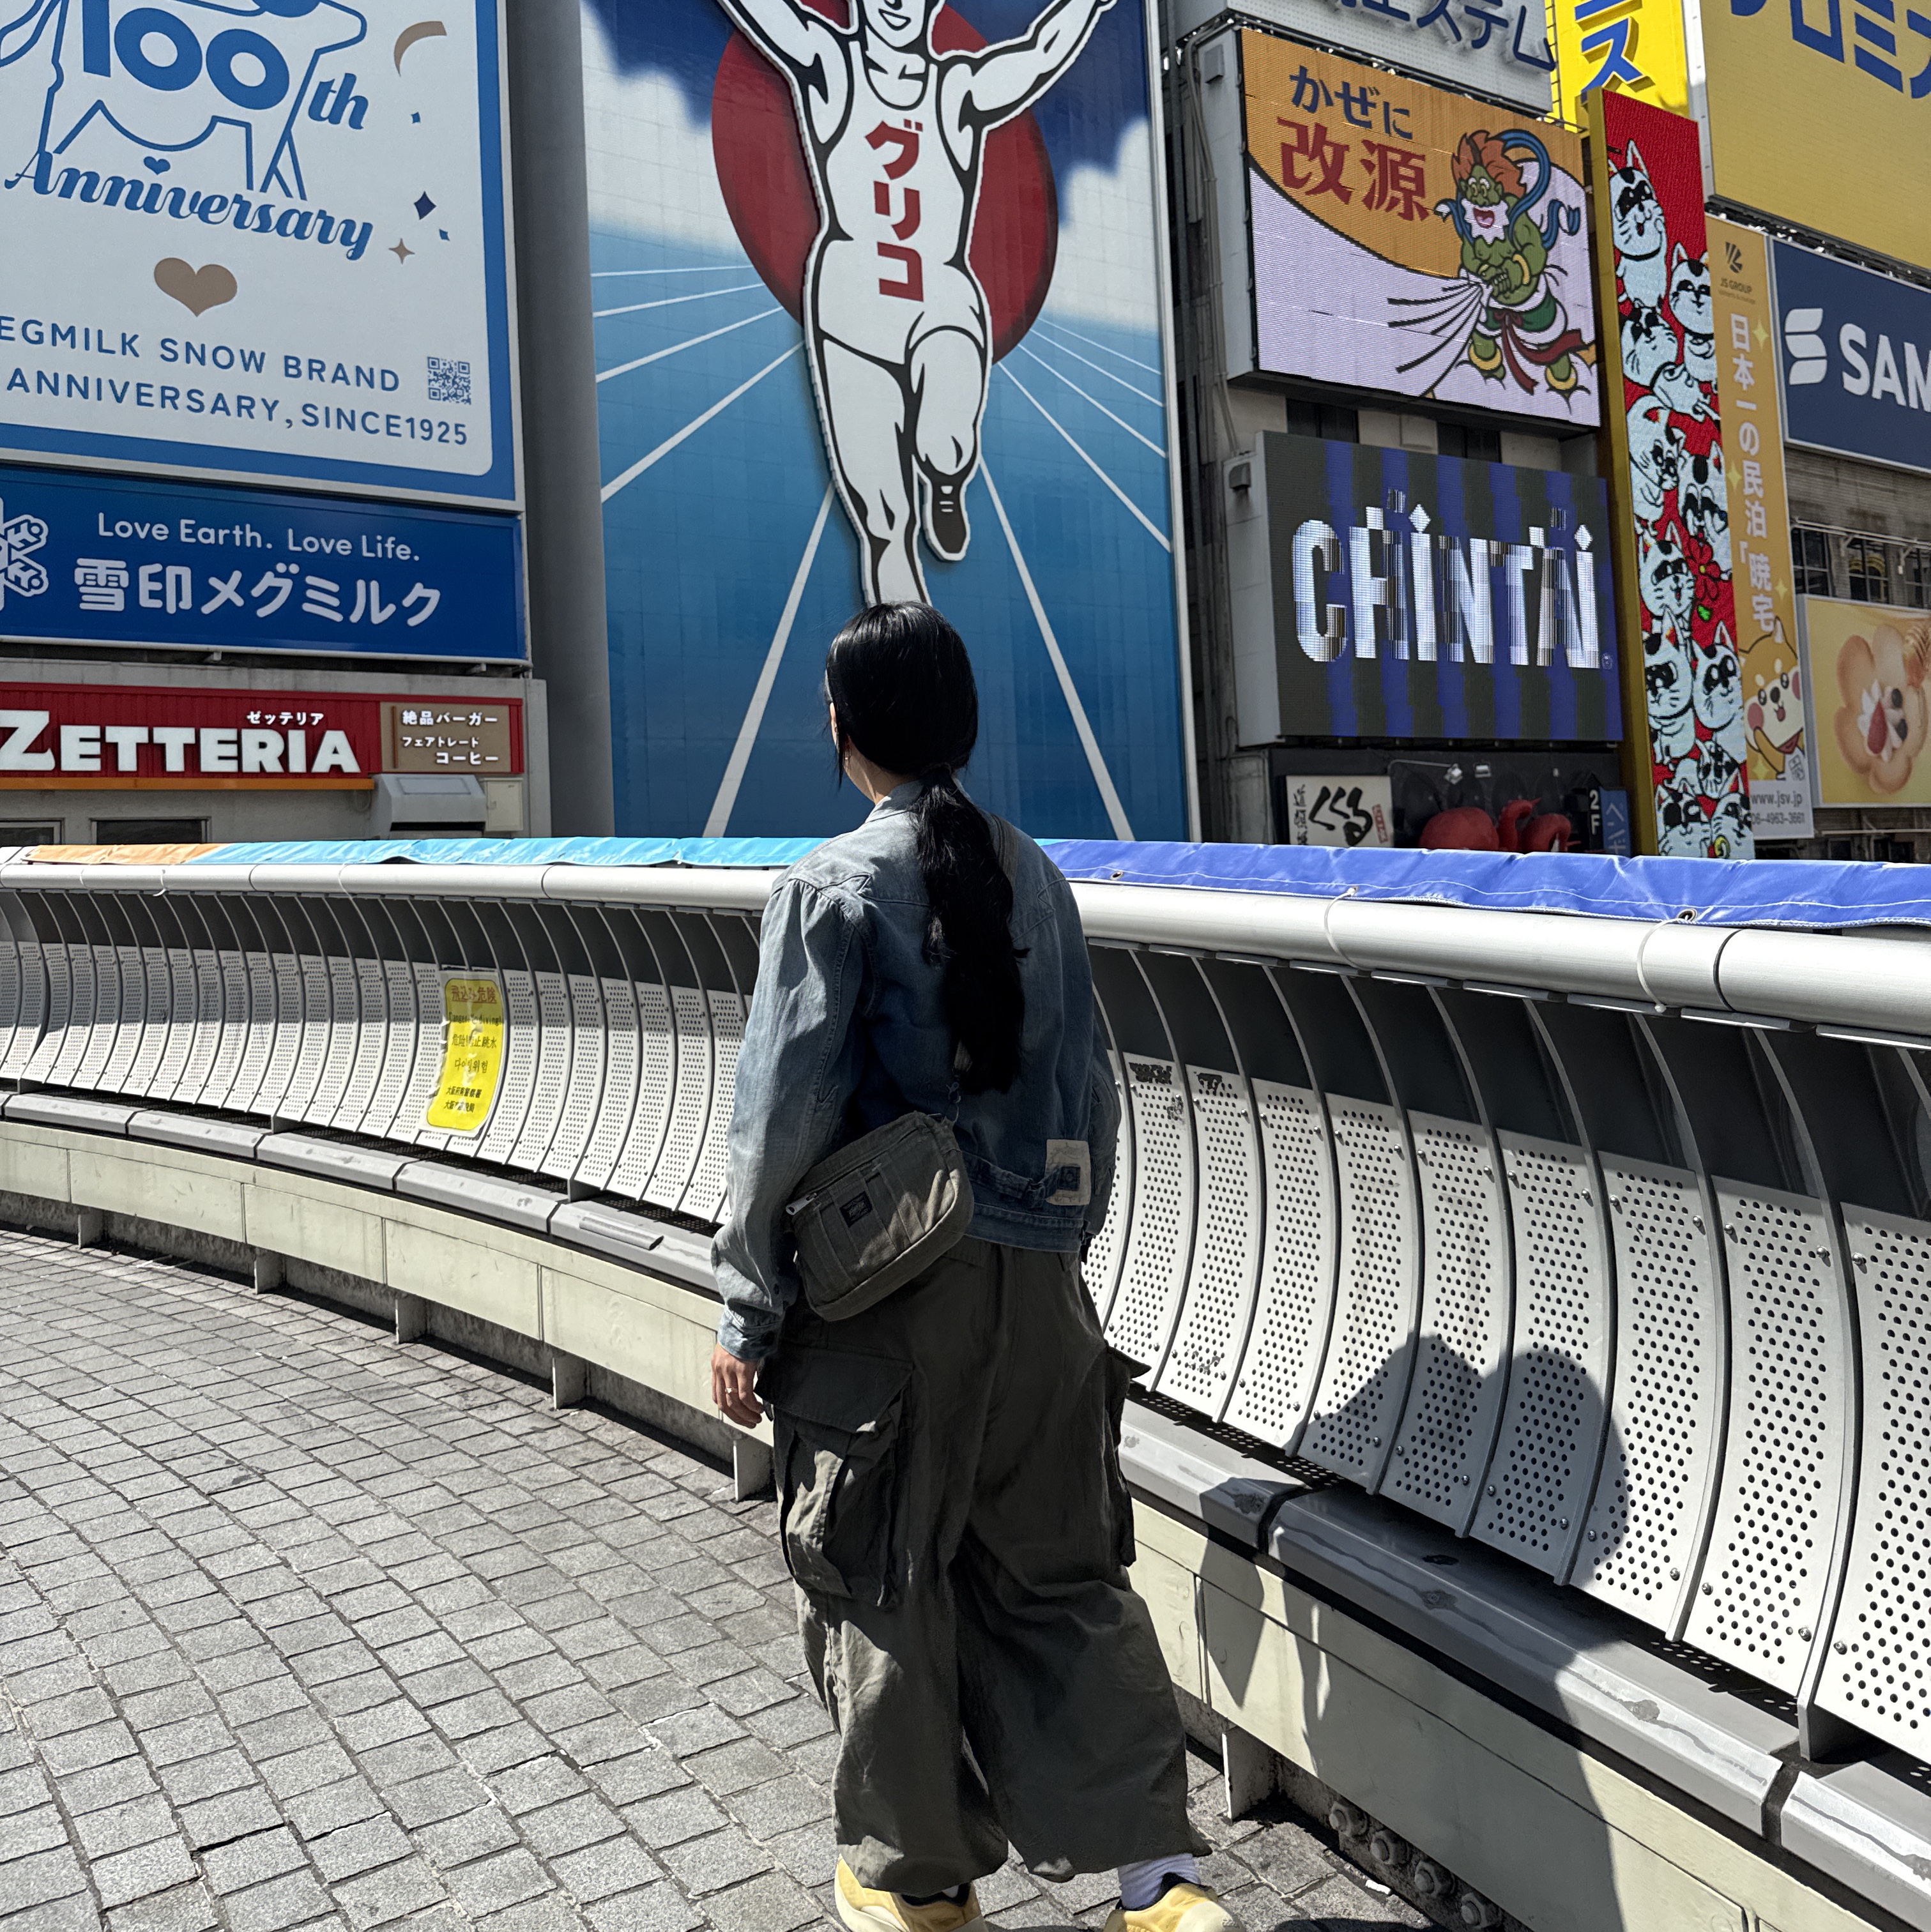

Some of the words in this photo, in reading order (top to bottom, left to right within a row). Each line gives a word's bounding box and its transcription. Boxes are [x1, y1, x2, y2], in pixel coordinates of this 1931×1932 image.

[1289, 65, 1414, 140] かぜに
[1277, 117, 1430, 223] 改源
[4, 151, 374, 261] Anniversary
[864, 118, 924, 303] グリコ
[160, 338, 266, 374] SNOW
[284, 355, 400, 392] BRAND
[98, 512, 169, 541] Love
[180, 519, 273, 549] Earth.
[287, 528, 353, 555] Love
[362, 535, 420, 561] Life.
[74, 558, 441, 627] 雪印メグミルク
[1291, 492, 1601, 669] CHINTAI
[0, 710, 362, 773] ZETTERIA
[247, 711, 324, 726] ゼッテリア
[402, 710, 498, 726] 絶品バーガー
[402, 736, 479, 748] フェアトレード
[436, 751, 499, 765] コーヒー
[1308, 786, 1373, 846] くくる
[1589, 789, 1600, 835] 2F
